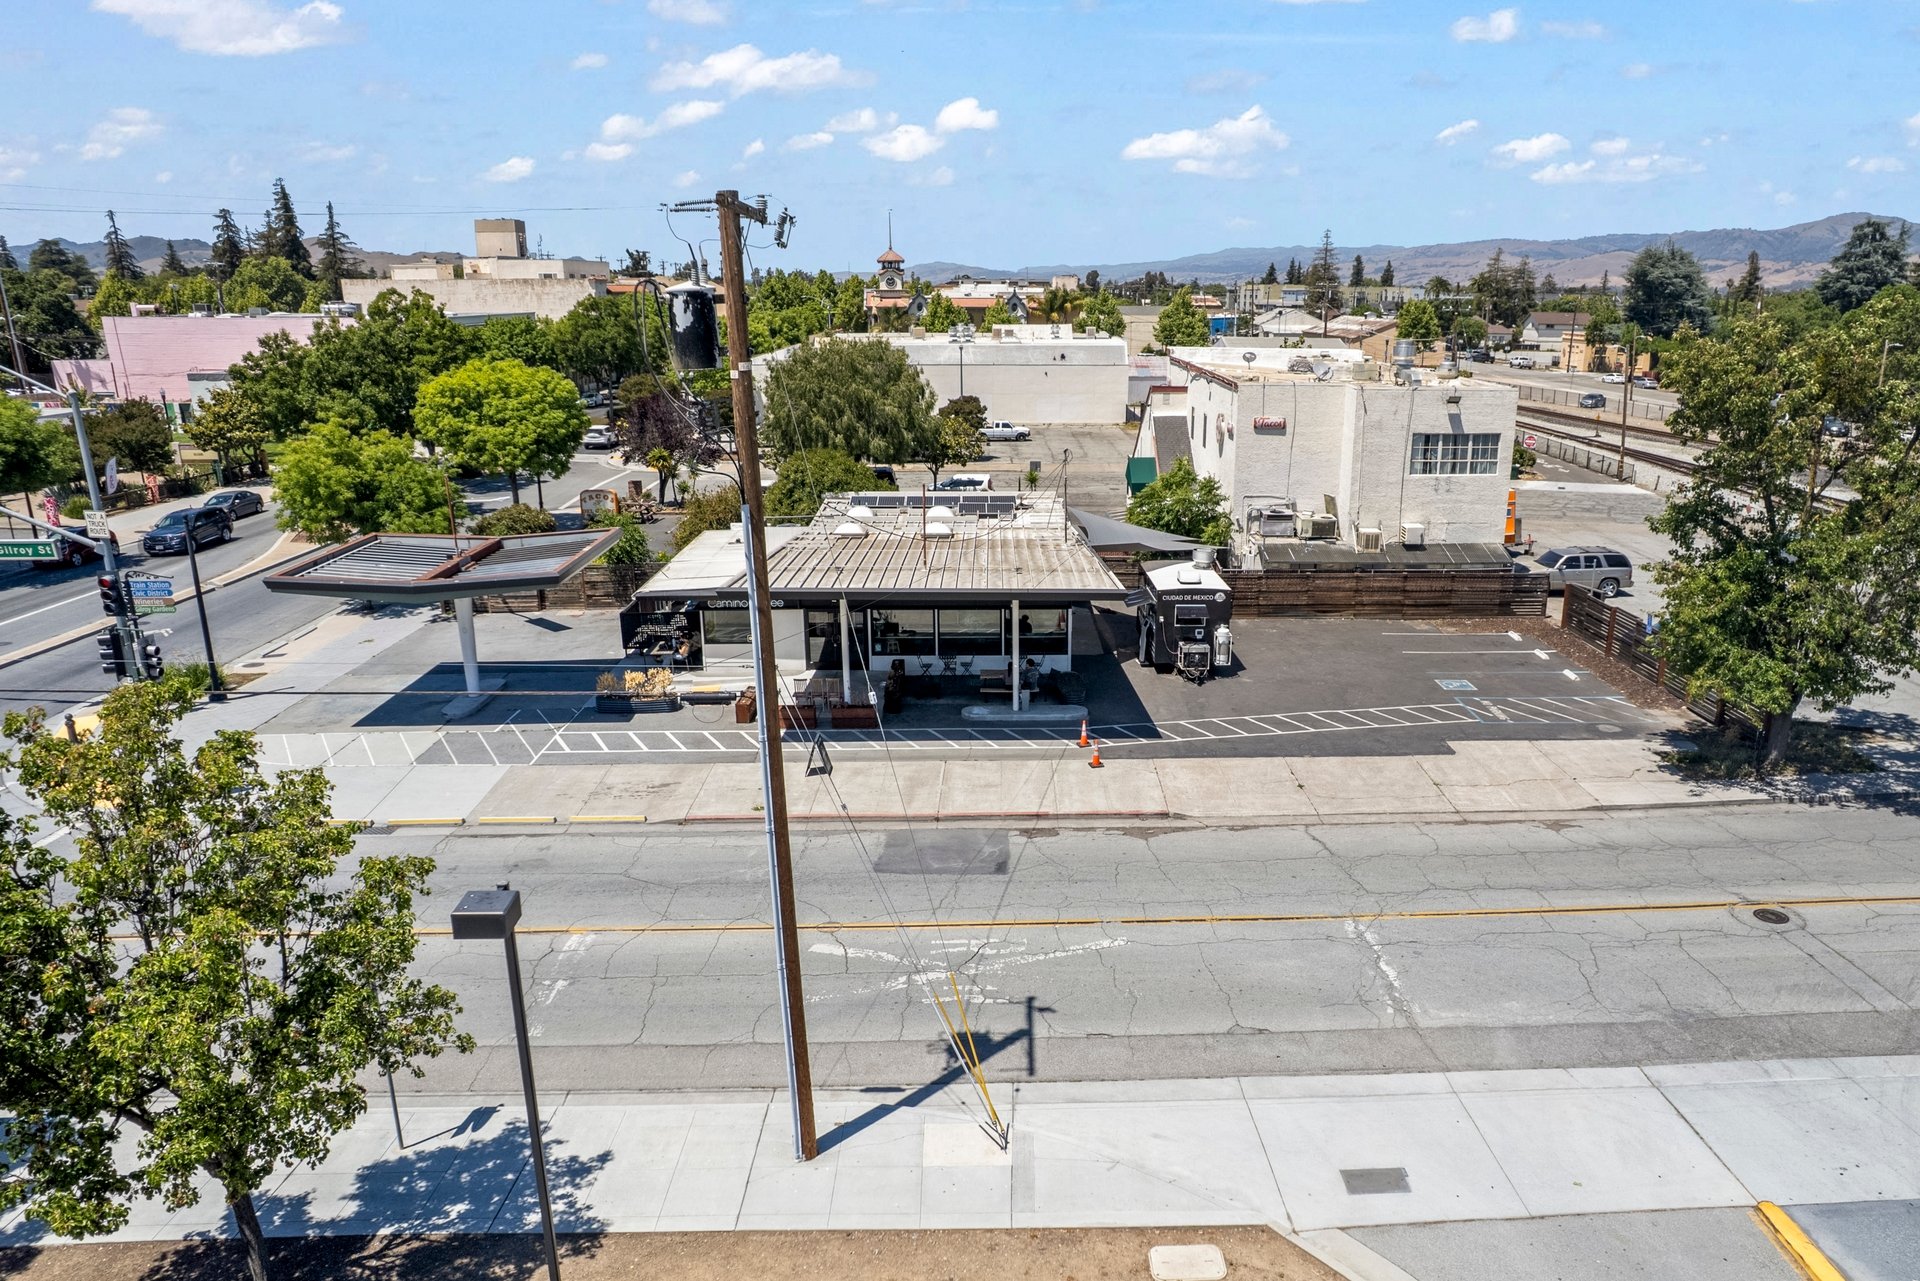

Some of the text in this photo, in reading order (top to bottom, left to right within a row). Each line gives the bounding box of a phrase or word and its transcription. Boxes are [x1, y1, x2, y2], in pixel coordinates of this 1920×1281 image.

[1257, 417, 1284, 429] Tacos
[90, 527, 107, 535] ROUTE
[38, 545, 52, 554] St
[707, 599, 749, 608] Camino
